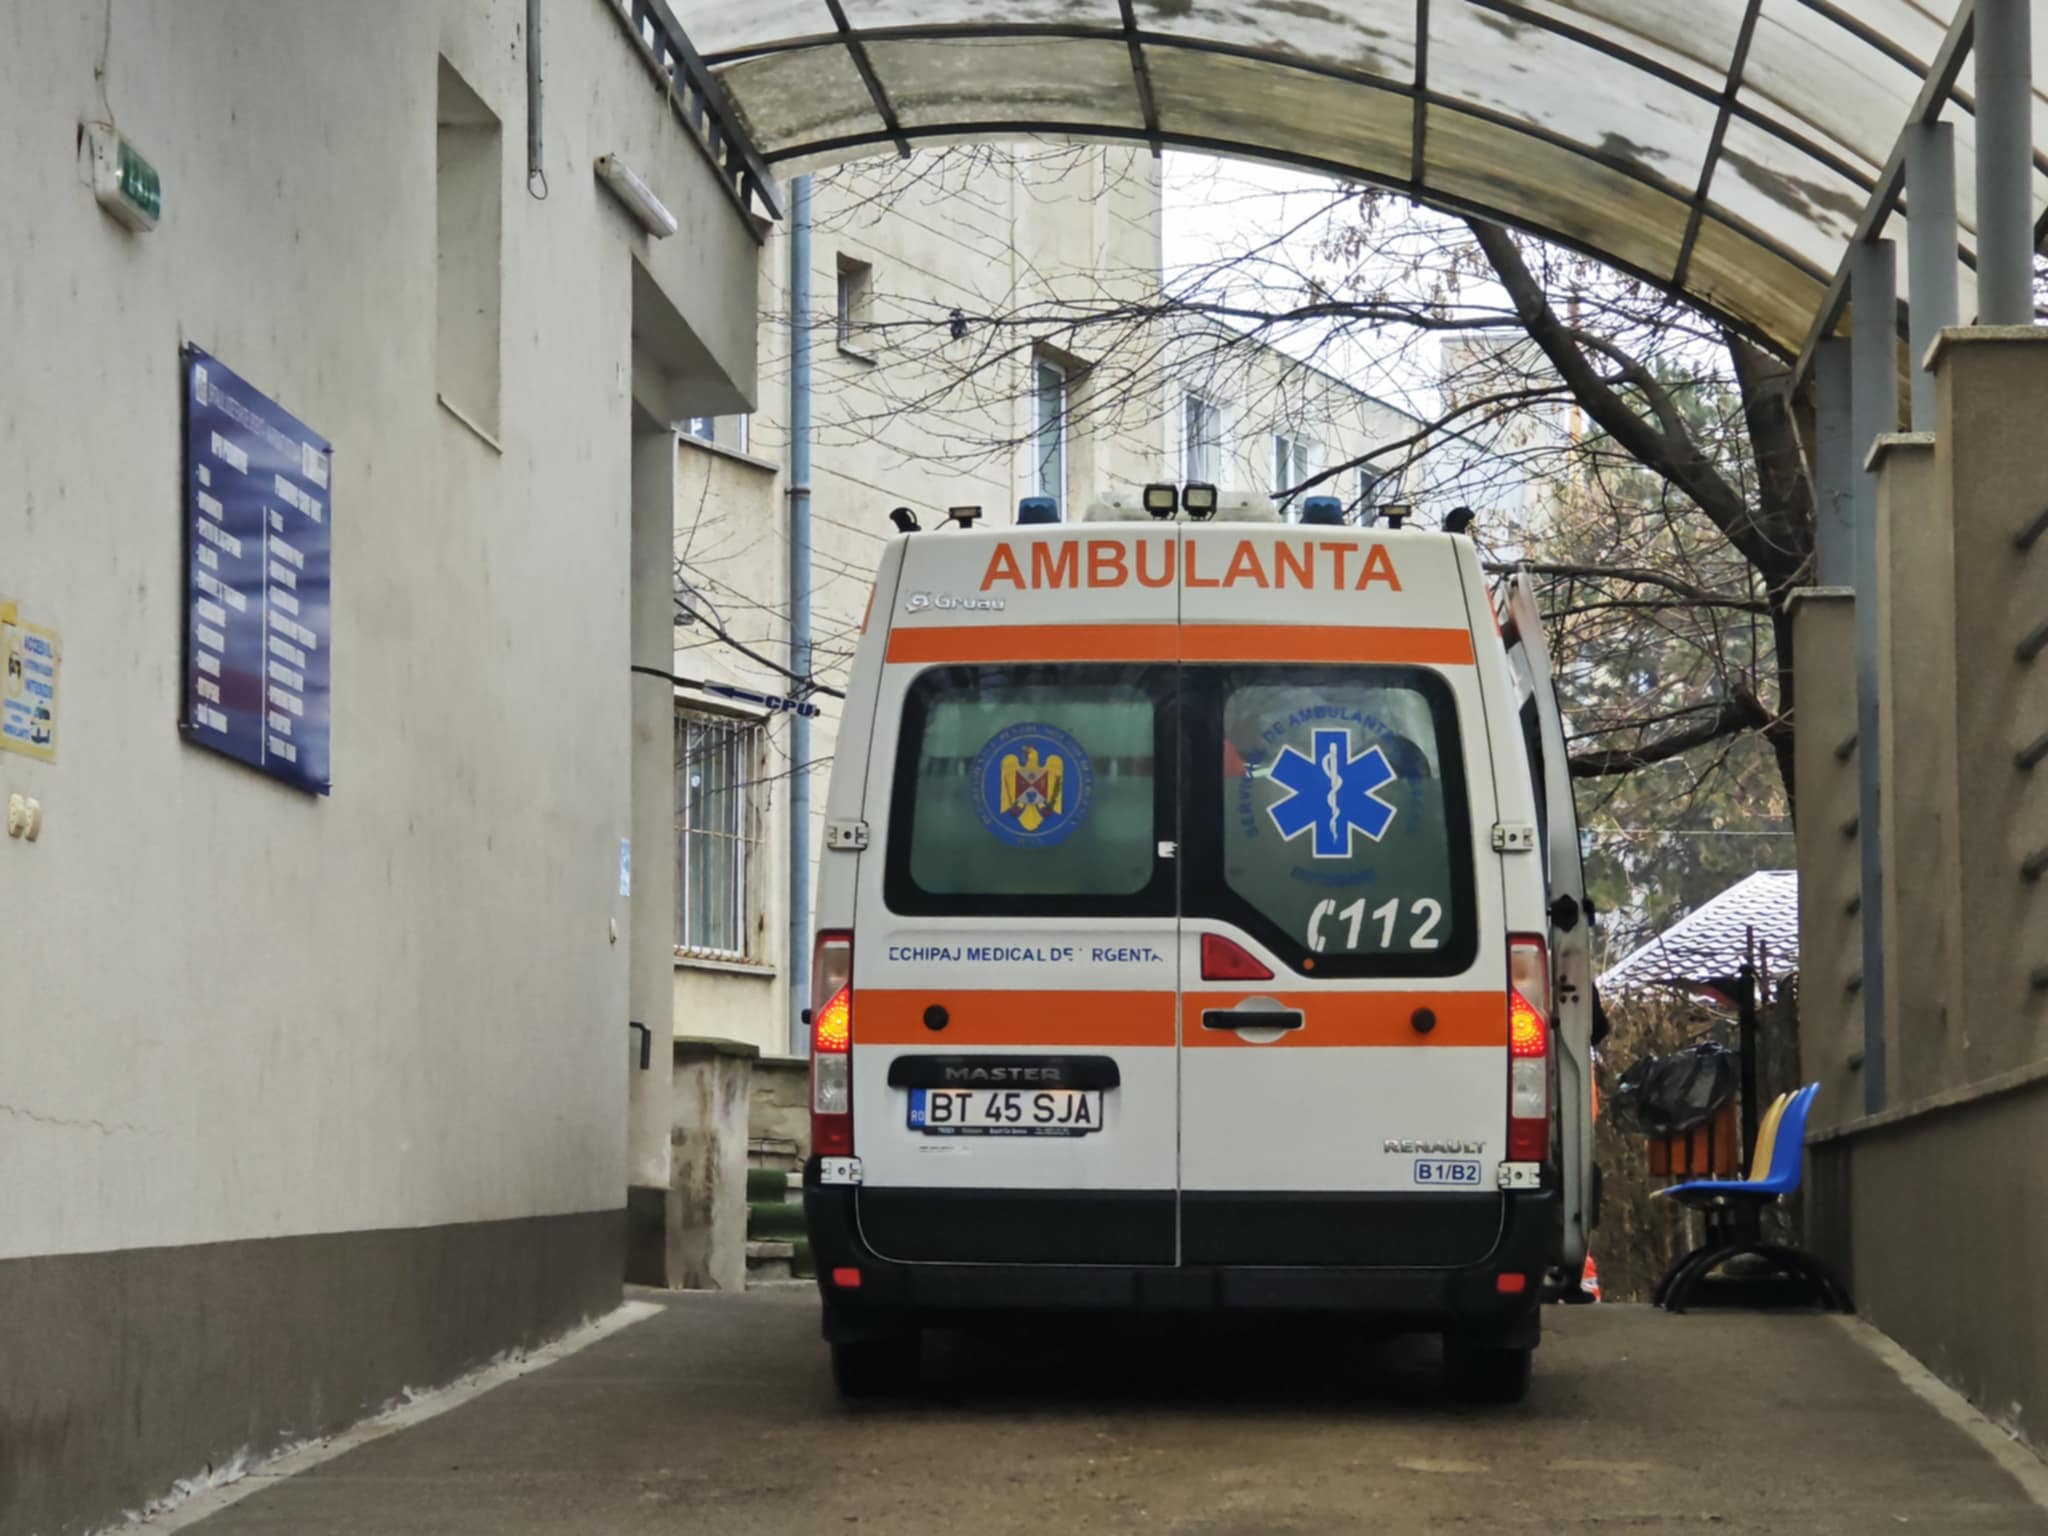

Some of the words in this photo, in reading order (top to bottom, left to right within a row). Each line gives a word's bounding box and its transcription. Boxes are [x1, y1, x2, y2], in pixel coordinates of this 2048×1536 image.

[980, 540, 1402, 592] AMBULANTA
[935, 594, 1005, 611] Gruau
[765, 695, 815, 716] CPU
[1339, 898, 1442, 949] 112
[889, 946, 962, 961] ECHIPAJ
[967, 947, 1046, 962] MEDICAL
[945, 1067, 1062, 1081] MASTER
[931, 1093, 972, 1122] BT
[985, 1093, 1022, 1122] 45
[1033, 1094, 1091, 1124] SJA
[1383, 1139, 1486, 1154] RENAULT
